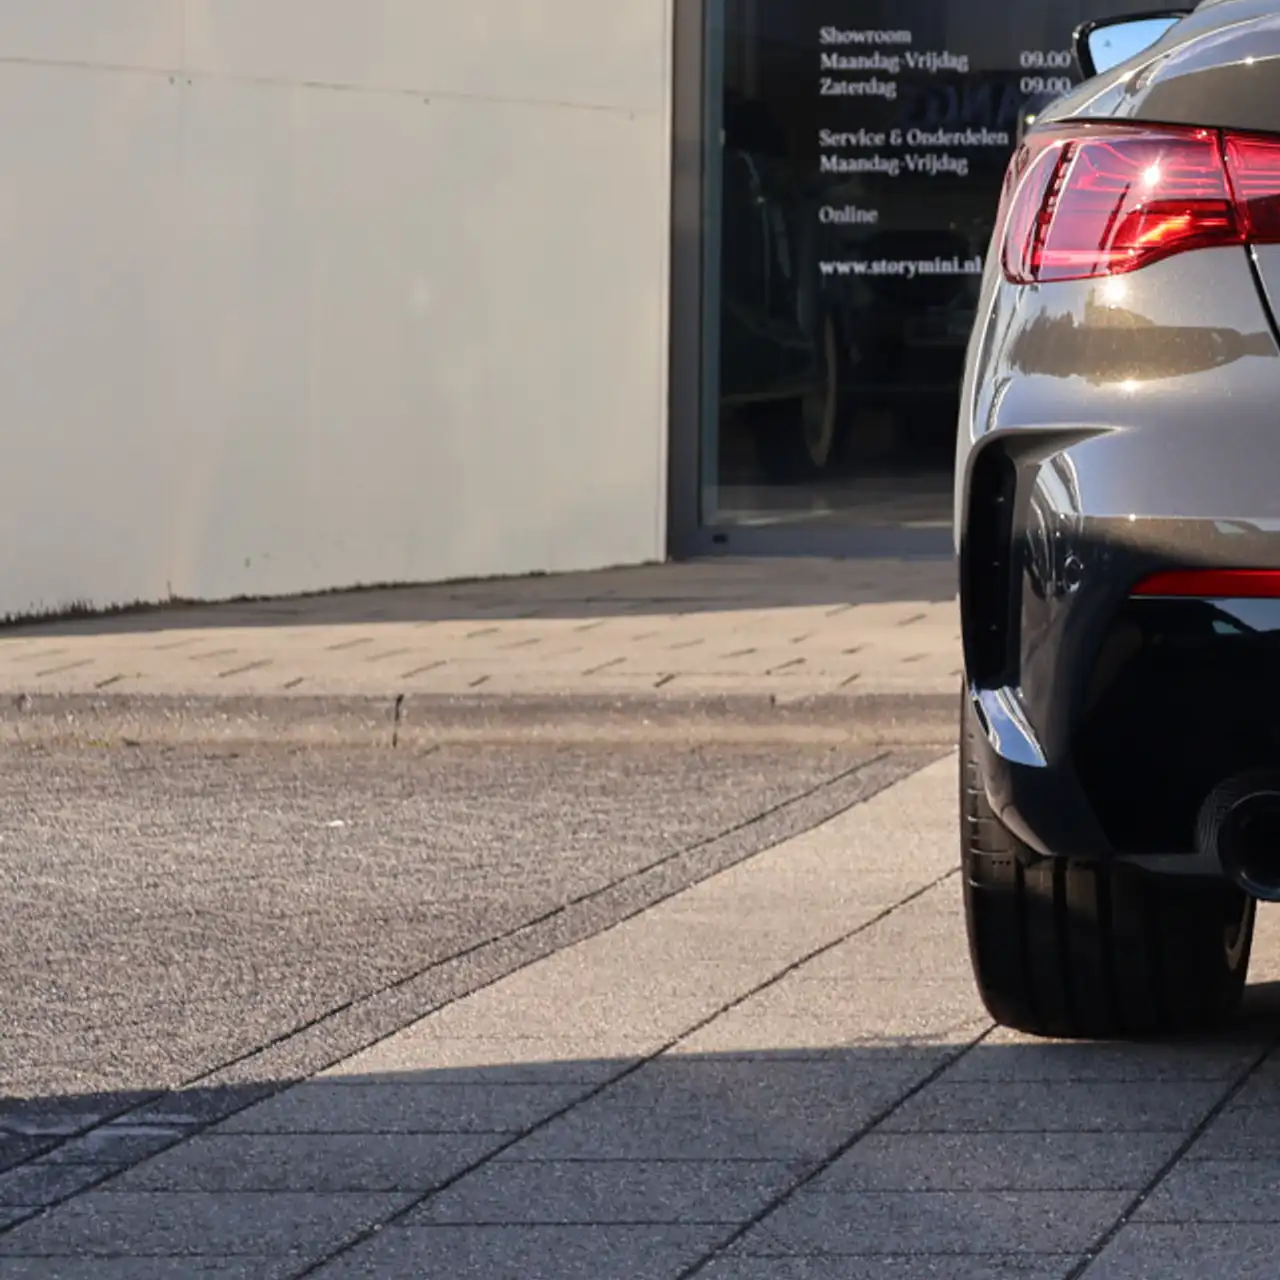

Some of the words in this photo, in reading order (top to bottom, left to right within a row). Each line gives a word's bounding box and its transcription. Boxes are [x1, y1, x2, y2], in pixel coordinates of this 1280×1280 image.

[819, 27, 911, 44] Showroom
[1020, 50, 1071, 68] 09.00
[819, 78, 897, 99] Zaterdag
[1020, 76, 1071, 94] 09.00
[819, 129, 885, 147] Service
[889, 128, 901, 144] &
[905, 128, 1009, 146] Onderdelen
[819, 206, 879, 224] Online
[819, 256, 983, 278] www.storymini.nl
